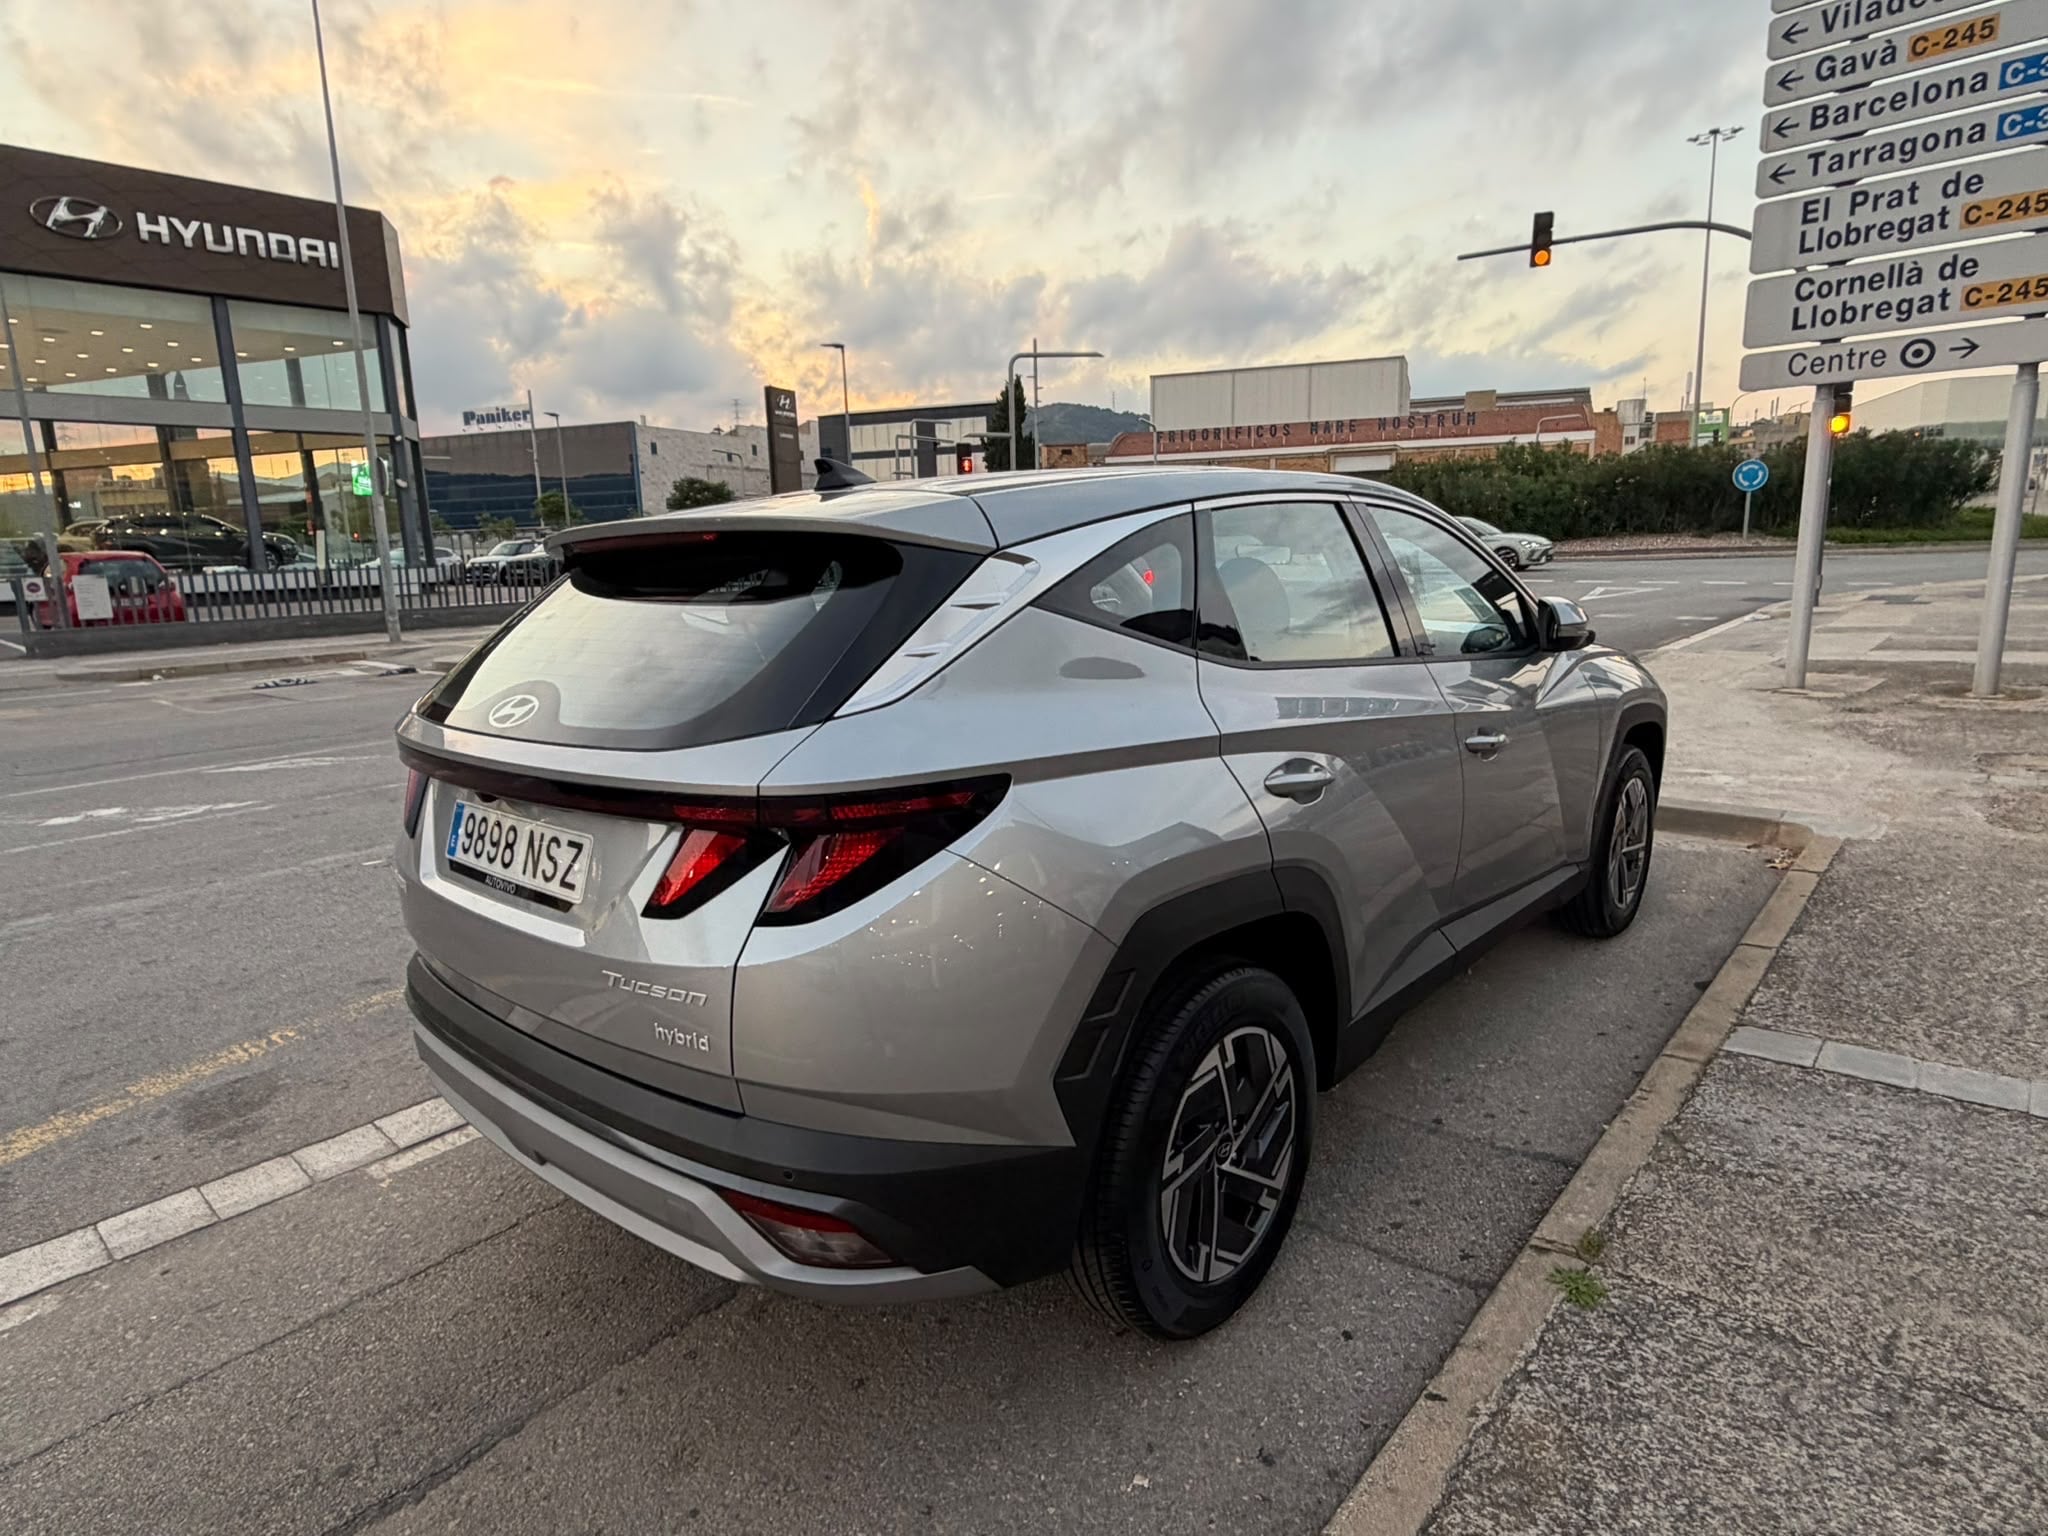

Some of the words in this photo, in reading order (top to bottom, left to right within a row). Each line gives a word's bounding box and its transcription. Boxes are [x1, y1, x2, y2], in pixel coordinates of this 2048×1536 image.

[1815, 39, 1897, 83] Gavà
[1911, 18, 1996, 57] C-245
[1810, 71, 1989, 131] Barcelona
[1807, 122, 1986, 177] Tarragona
[1799, 205, 1950, 254] Llobregat
[1964, 192, 2048, 225] C-245
[1801, 196, 1831, 225] El
[1850, 180, 1920, 216] Prat
[1941, 171, 1984, 200] de
[136, 212, 340, 269] HYUNDAI
[1791, 288, 1950, 331] Llobregat
[1964, 277, 2048, 307] C-245
[1794, 261, 1923, 302] Cornellà
[1938, 254, 1979, 282] de
[1788, 348, 1887, 377] Centre
[463, 406, 531, 426] Paniker
[1156, 423, 1292, 444] FRIGORIFICOS
[1310, 419, 1356, 435] MARE
[1378, 412, 1477, 431] NOSTRUM
[462, 812, 518, 870] 9898
[522, 827, 585, 892] NSZ
[654, 1022, 710, 1052] hybrid
